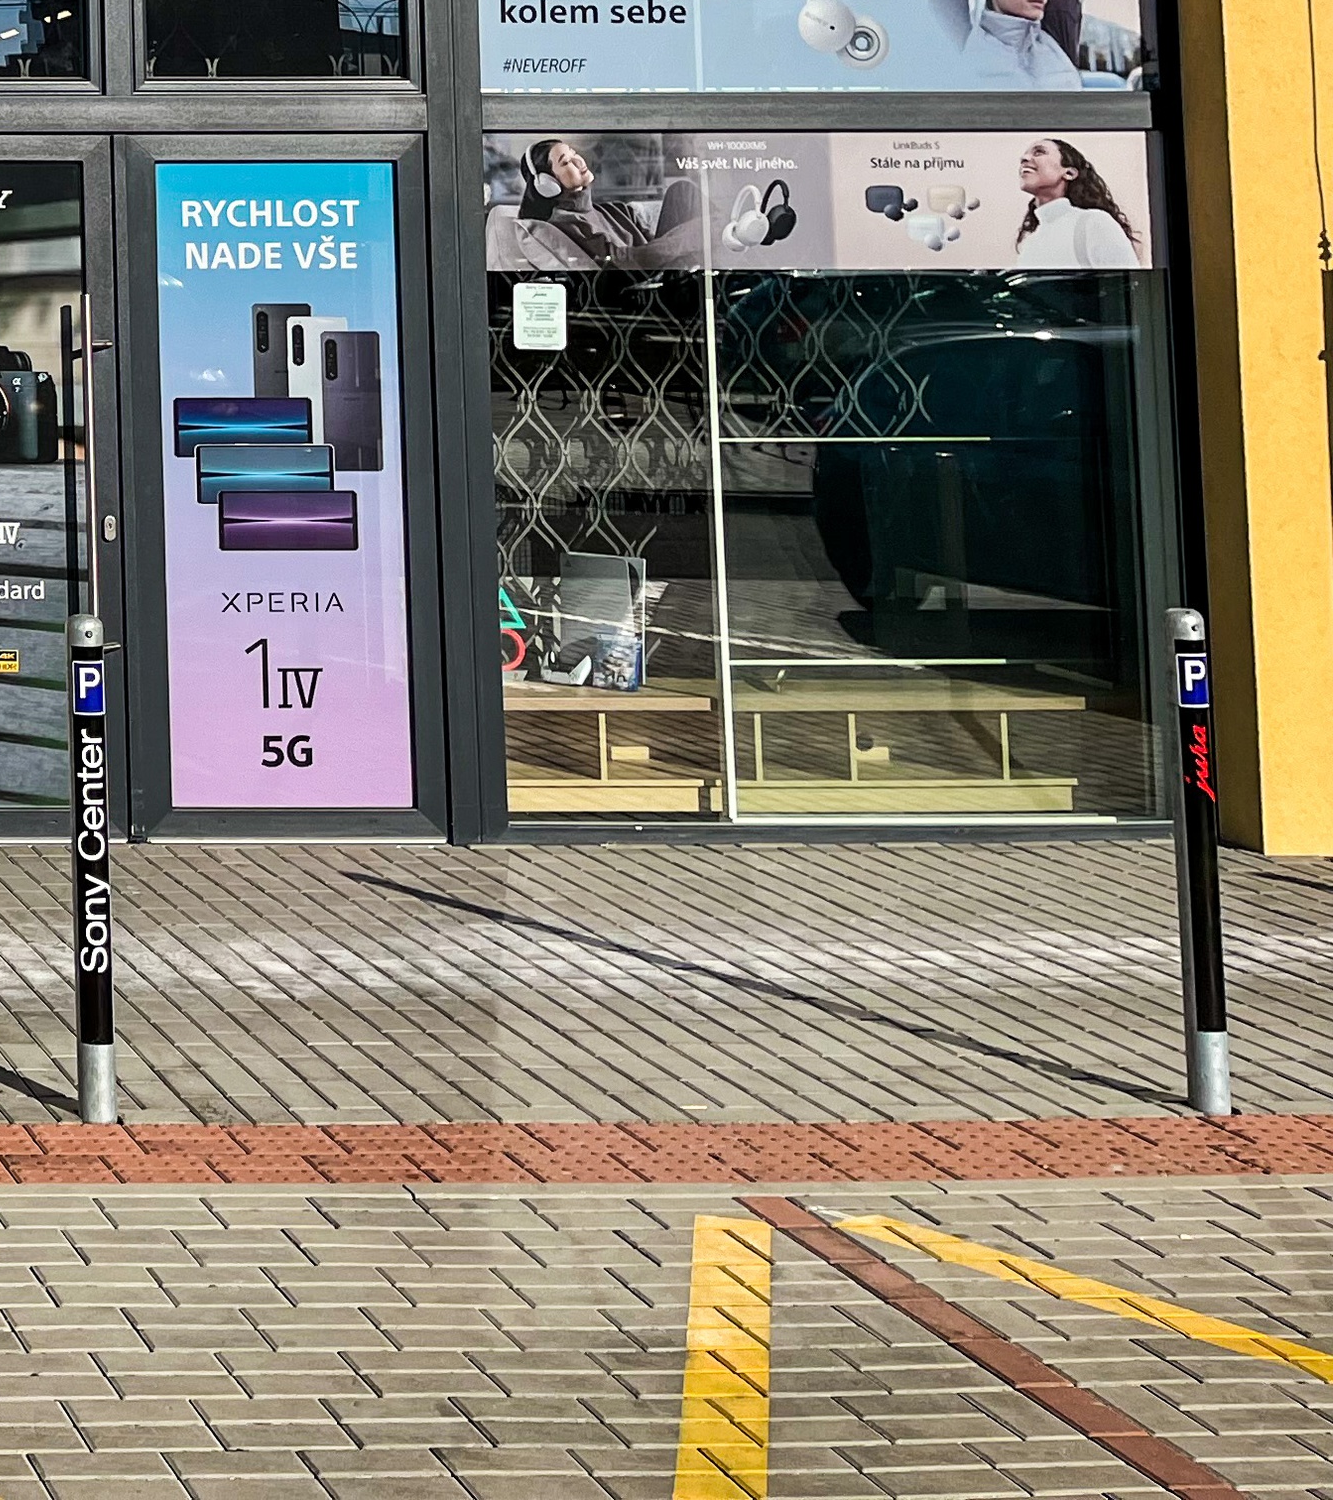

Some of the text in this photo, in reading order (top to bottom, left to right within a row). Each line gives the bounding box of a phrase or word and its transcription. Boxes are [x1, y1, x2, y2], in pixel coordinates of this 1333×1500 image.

[500, 0, 687, 23] kolem sebe
[503, 58, 587, 73] #NEVEROFF
[676, 157, 699, 169] Váš
[733, 157, 753, 169] Nic
[870, 157, 964, 171] Stále na příjmu
[181, 199, 360, 228] RYCHLOST
[185, 235, 358, 270] NADE VŠE
[221, 592, 344, 613] XPERIA
[79, 667, 100, 699] P
[1184, 660, 1206, 691] P
[261, 735, 313, 767] 5G
[1184, 724, 1216, 803] jura
[77, 729, 112, 974] Sony Center
